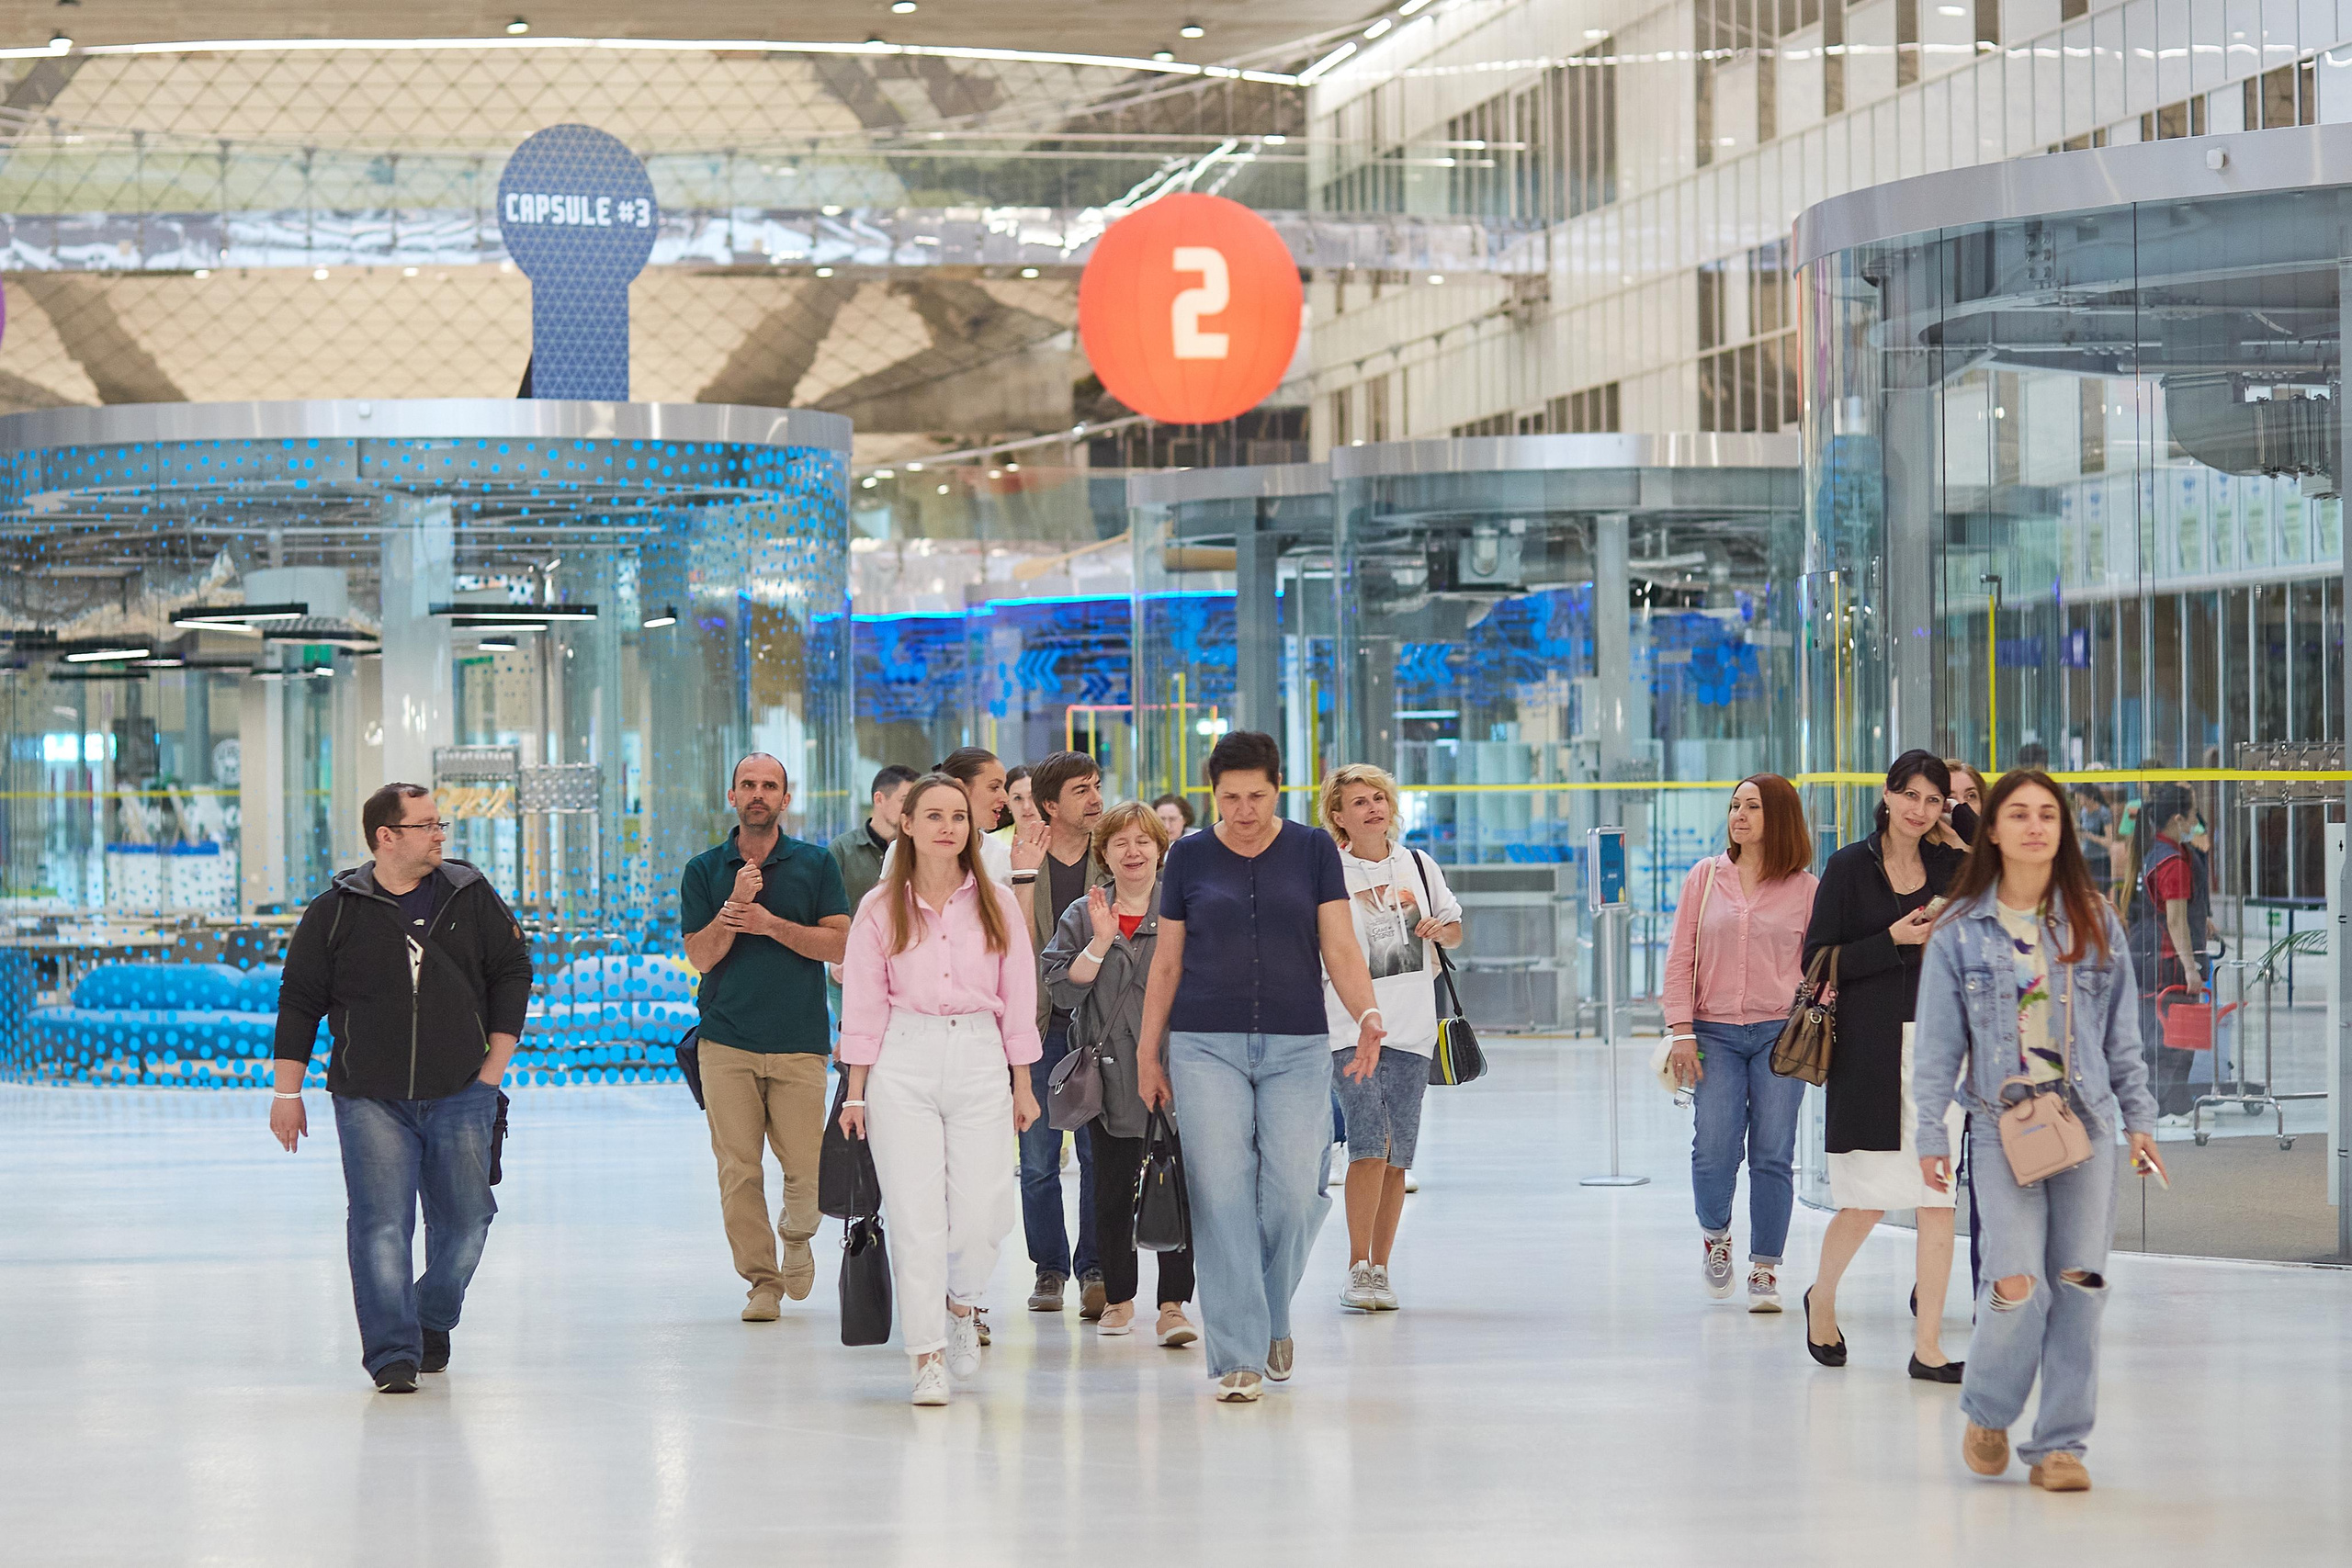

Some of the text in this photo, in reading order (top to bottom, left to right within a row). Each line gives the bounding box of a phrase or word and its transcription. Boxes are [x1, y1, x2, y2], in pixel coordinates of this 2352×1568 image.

[505, 192, 651, 229] CAPSULE #3
[1171, 245, 1230, 359] 2
